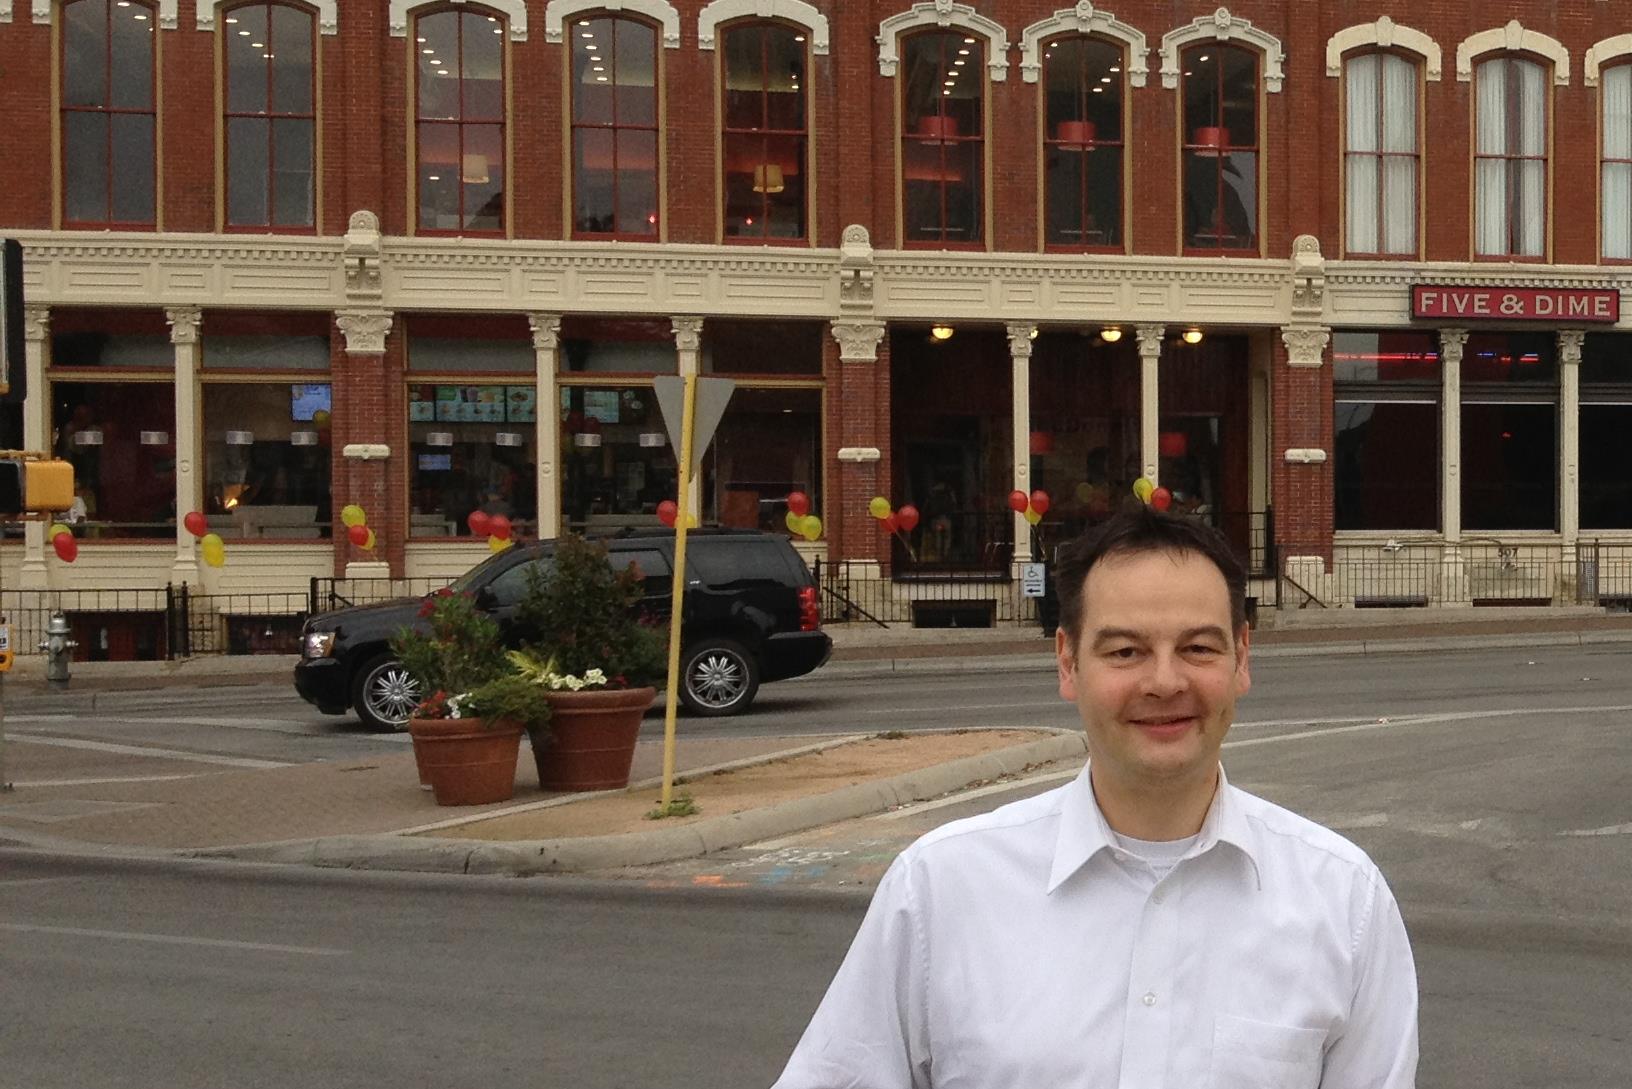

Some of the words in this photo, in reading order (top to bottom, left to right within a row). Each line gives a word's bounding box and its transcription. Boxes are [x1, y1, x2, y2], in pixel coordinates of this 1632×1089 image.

[1420, 292, 1490, 314] FIVE
[1500, 293, 1524, 315] &
[1535, 294, 1611, 317] DIME
